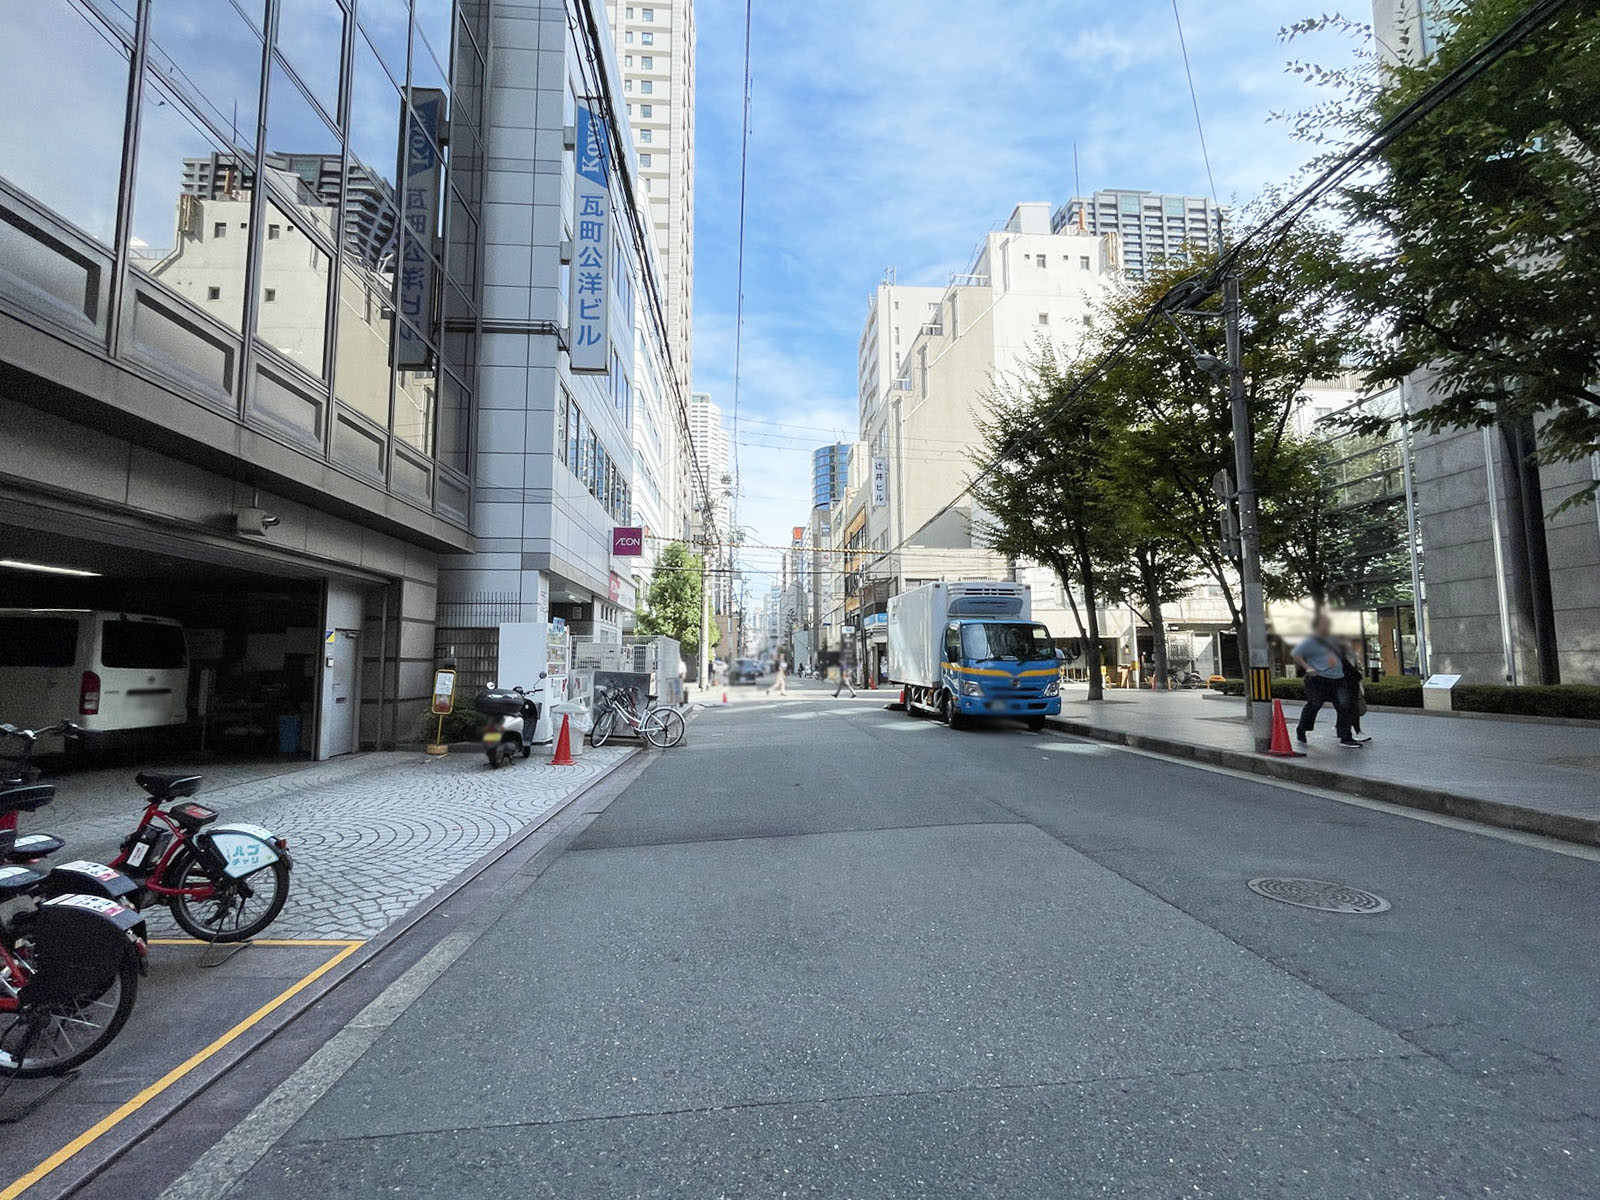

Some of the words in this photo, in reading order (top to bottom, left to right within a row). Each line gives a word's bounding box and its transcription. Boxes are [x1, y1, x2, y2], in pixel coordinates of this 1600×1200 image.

[581, 117, 602, 173] Koyo
[577, 195, 604, 346] 瓦町公洋ビル
